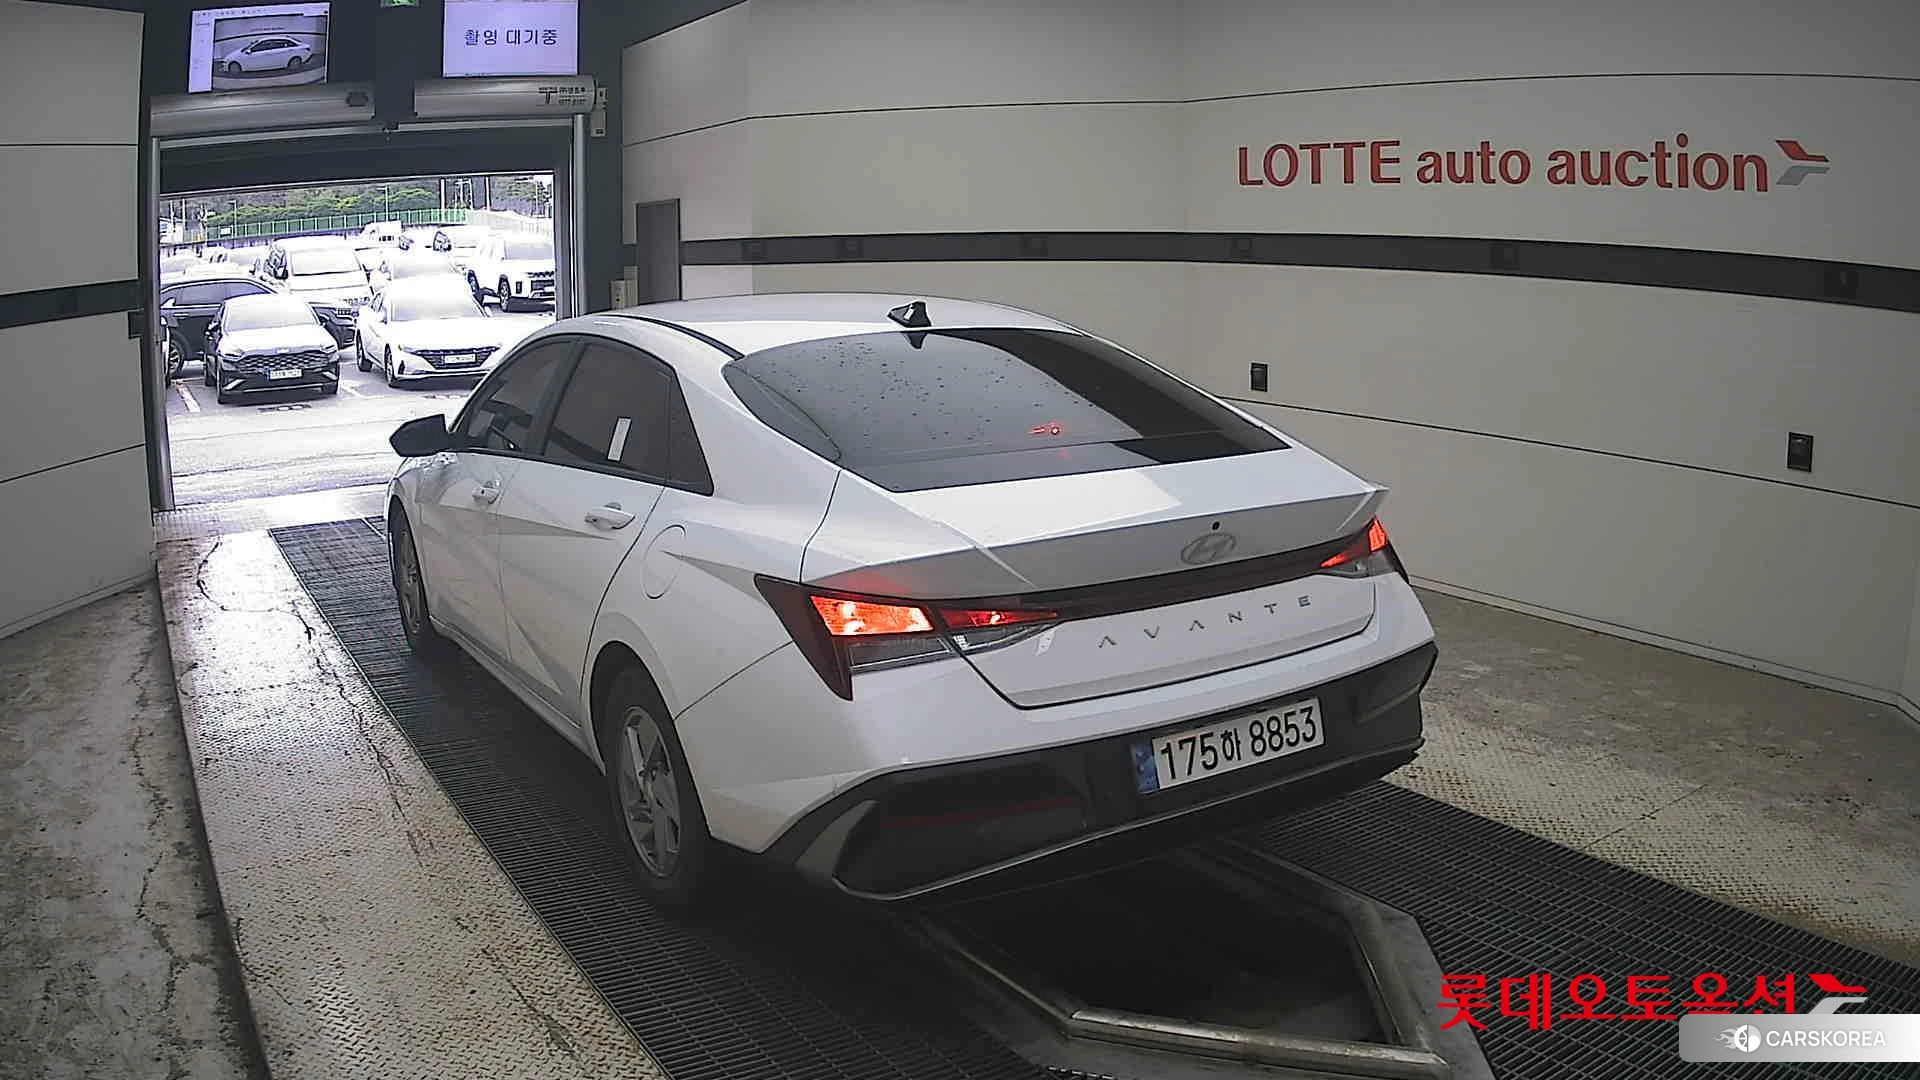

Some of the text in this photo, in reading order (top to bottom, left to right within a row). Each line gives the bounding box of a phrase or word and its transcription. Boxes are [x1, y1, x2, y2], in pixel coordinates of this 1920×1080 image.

[464, 28, 559, 46] 촬영 대기중
[1238, 133, 1769, 193] LOTTE auto auction
[1098, 595, 1312, 648] AVANTE
[1160, 705, 1317, 780] 175하 8853
